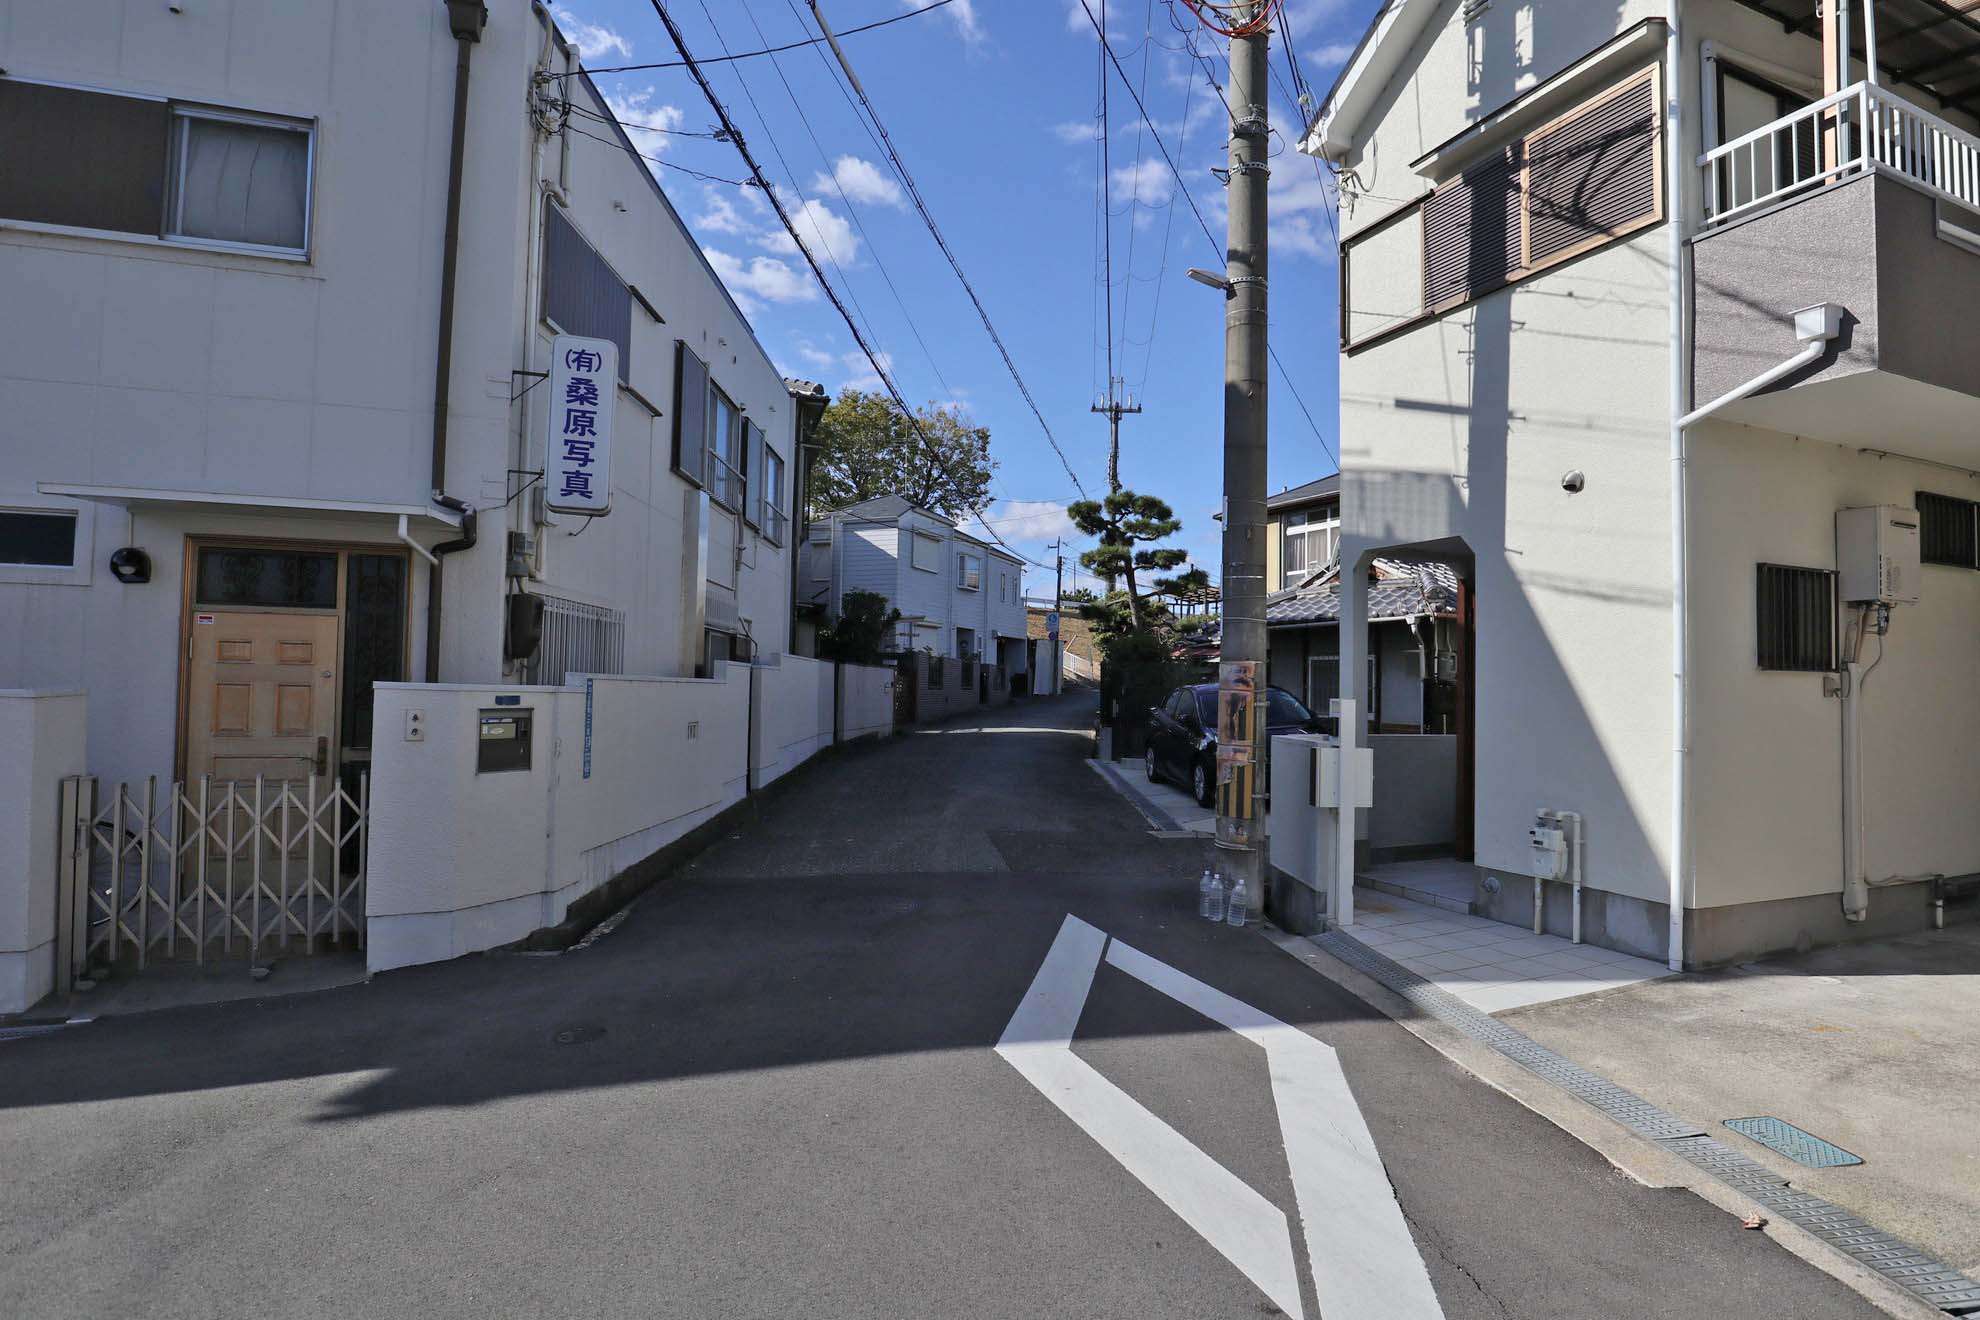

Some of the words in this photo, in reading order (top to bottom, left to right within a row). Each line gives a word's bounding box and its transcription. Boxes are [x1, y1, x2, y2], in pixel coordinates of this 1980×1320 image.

[560, 349, 602, 499] (有)桑原写真
